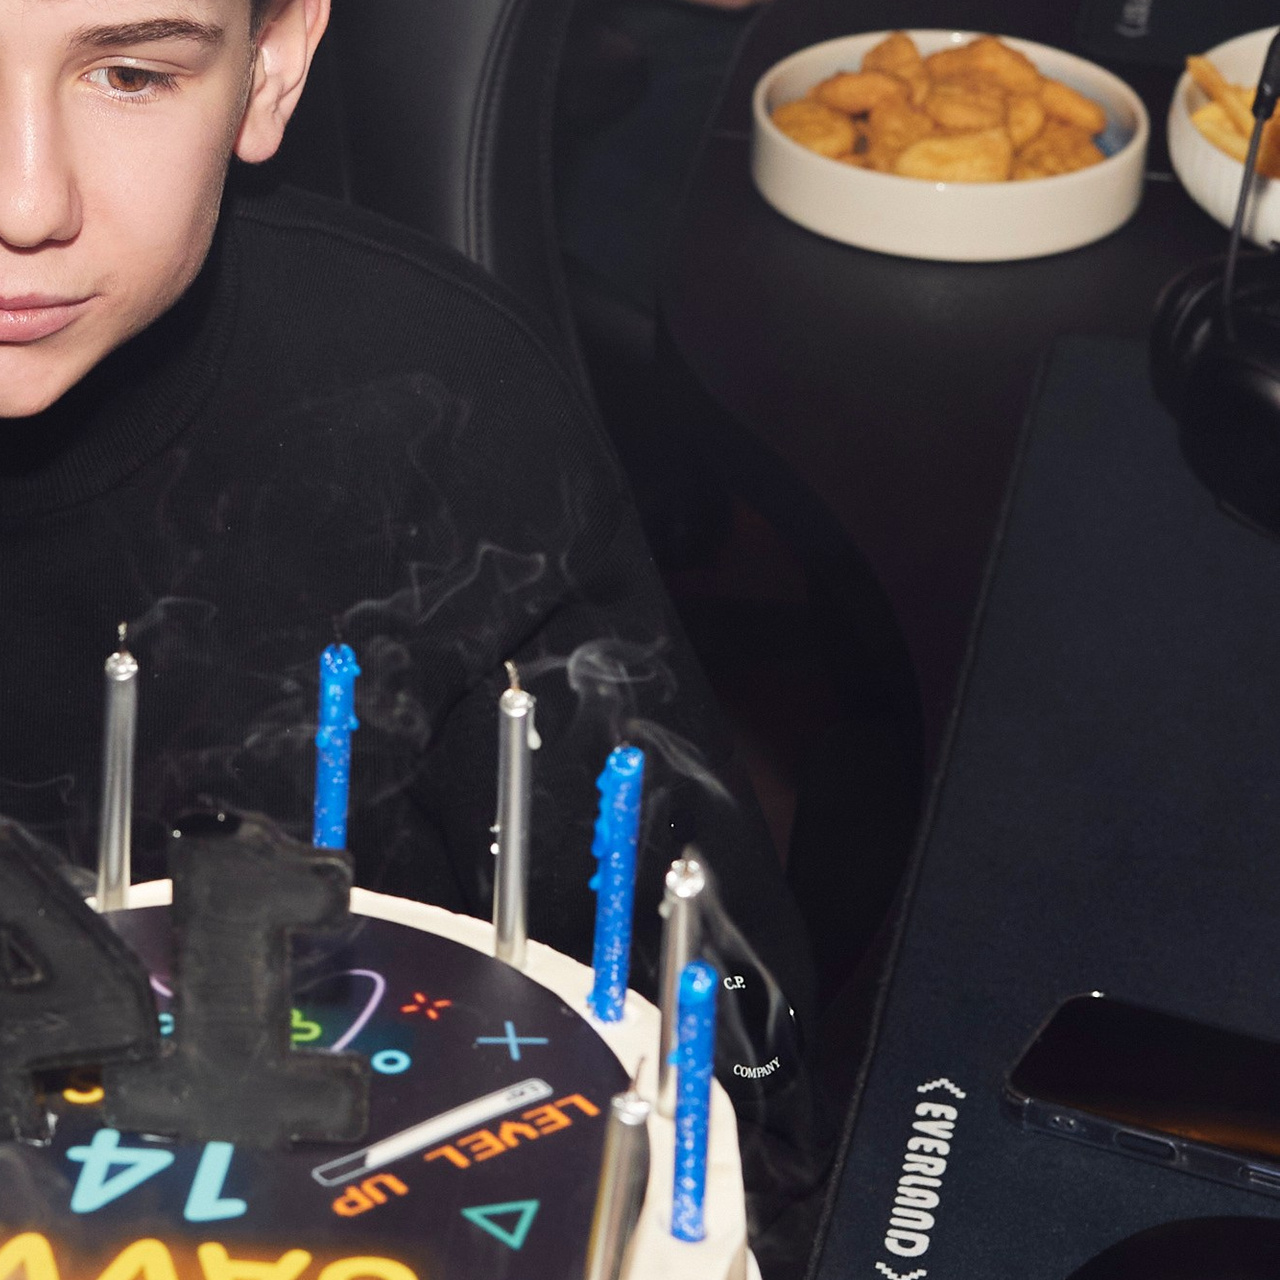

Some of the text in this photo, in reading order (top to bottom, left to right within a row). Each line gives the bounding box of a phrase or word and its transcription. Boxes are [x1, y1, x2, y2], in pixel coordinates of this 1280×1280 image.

[723, 975, 746, 991] C.P.
[733, 1056, 781, 1079] COMPANY
[423, 1093, 600, 1169] LEVEL
[66, 1127, 248, 1223] 14
[332, 1173, 409, 1217] UP
